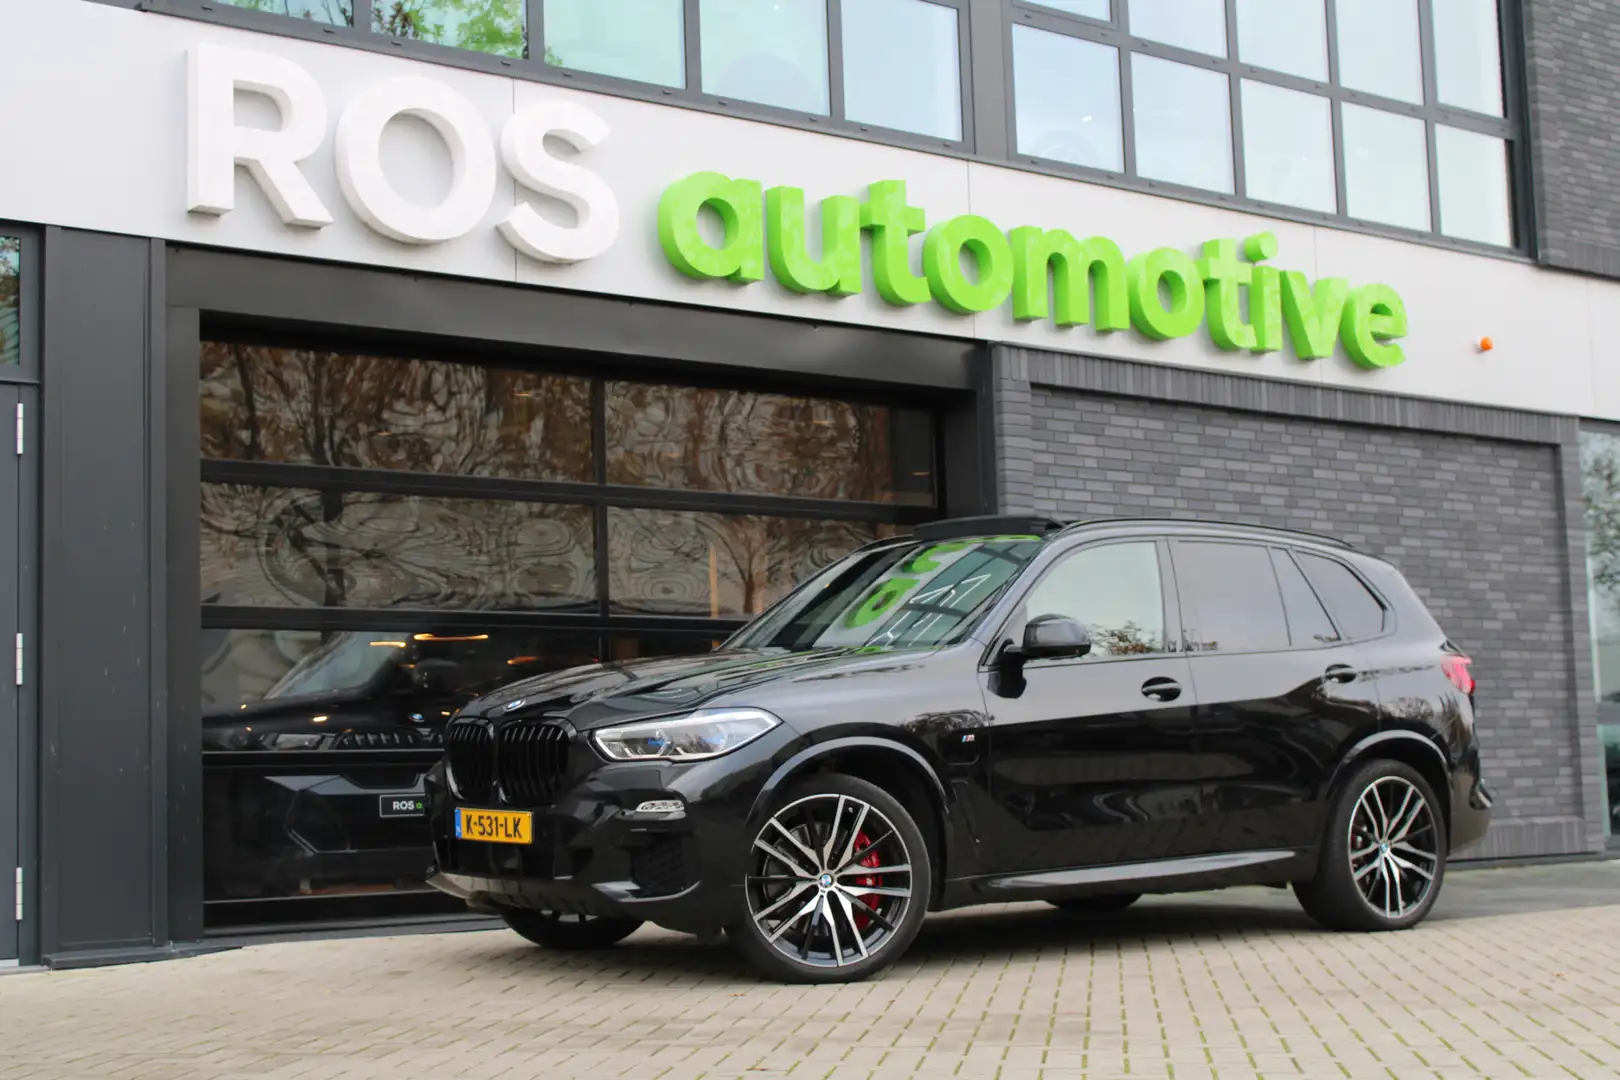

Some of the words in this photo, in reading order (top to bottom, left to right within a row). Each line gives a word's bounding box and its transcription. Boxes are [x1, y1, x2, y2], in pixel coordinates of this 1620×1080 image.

[186, 45, 620, 264] ROS
[658, 170, 1408, 370] automotive
[392, 800, 415, 811] ROS
[465, 814, 522, 838] K-531-LK
